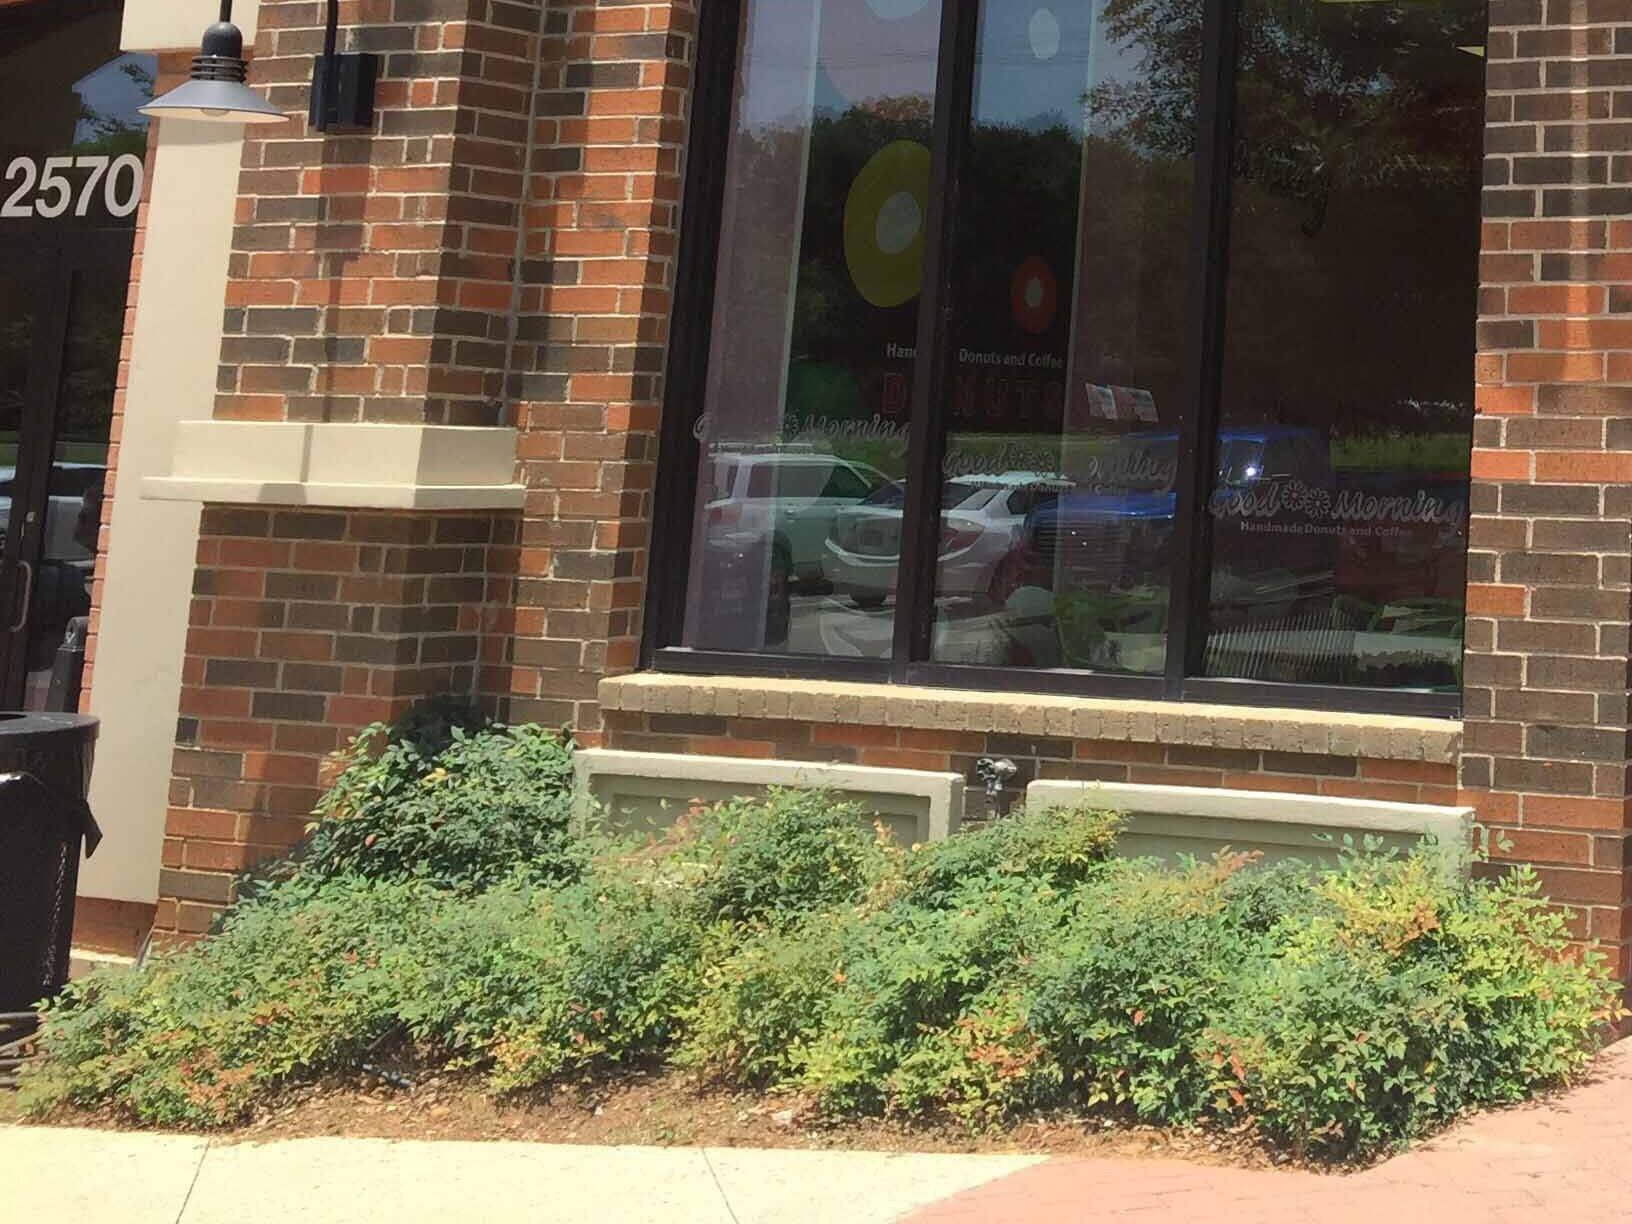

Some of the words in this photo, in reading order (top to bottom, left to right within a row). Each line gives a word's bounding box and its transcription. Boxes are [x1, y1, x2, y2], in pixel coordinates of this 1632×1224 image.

[1, 153, 144, 218] 2570
[959, 347, 1001, 365] Donuts
[1003, 350, 1024, 365] and
[1027, 351, 1063, 368] Coffee
[1208, 479, 1281, 519] Good
[1331, 489, 1466, 544] Morning
